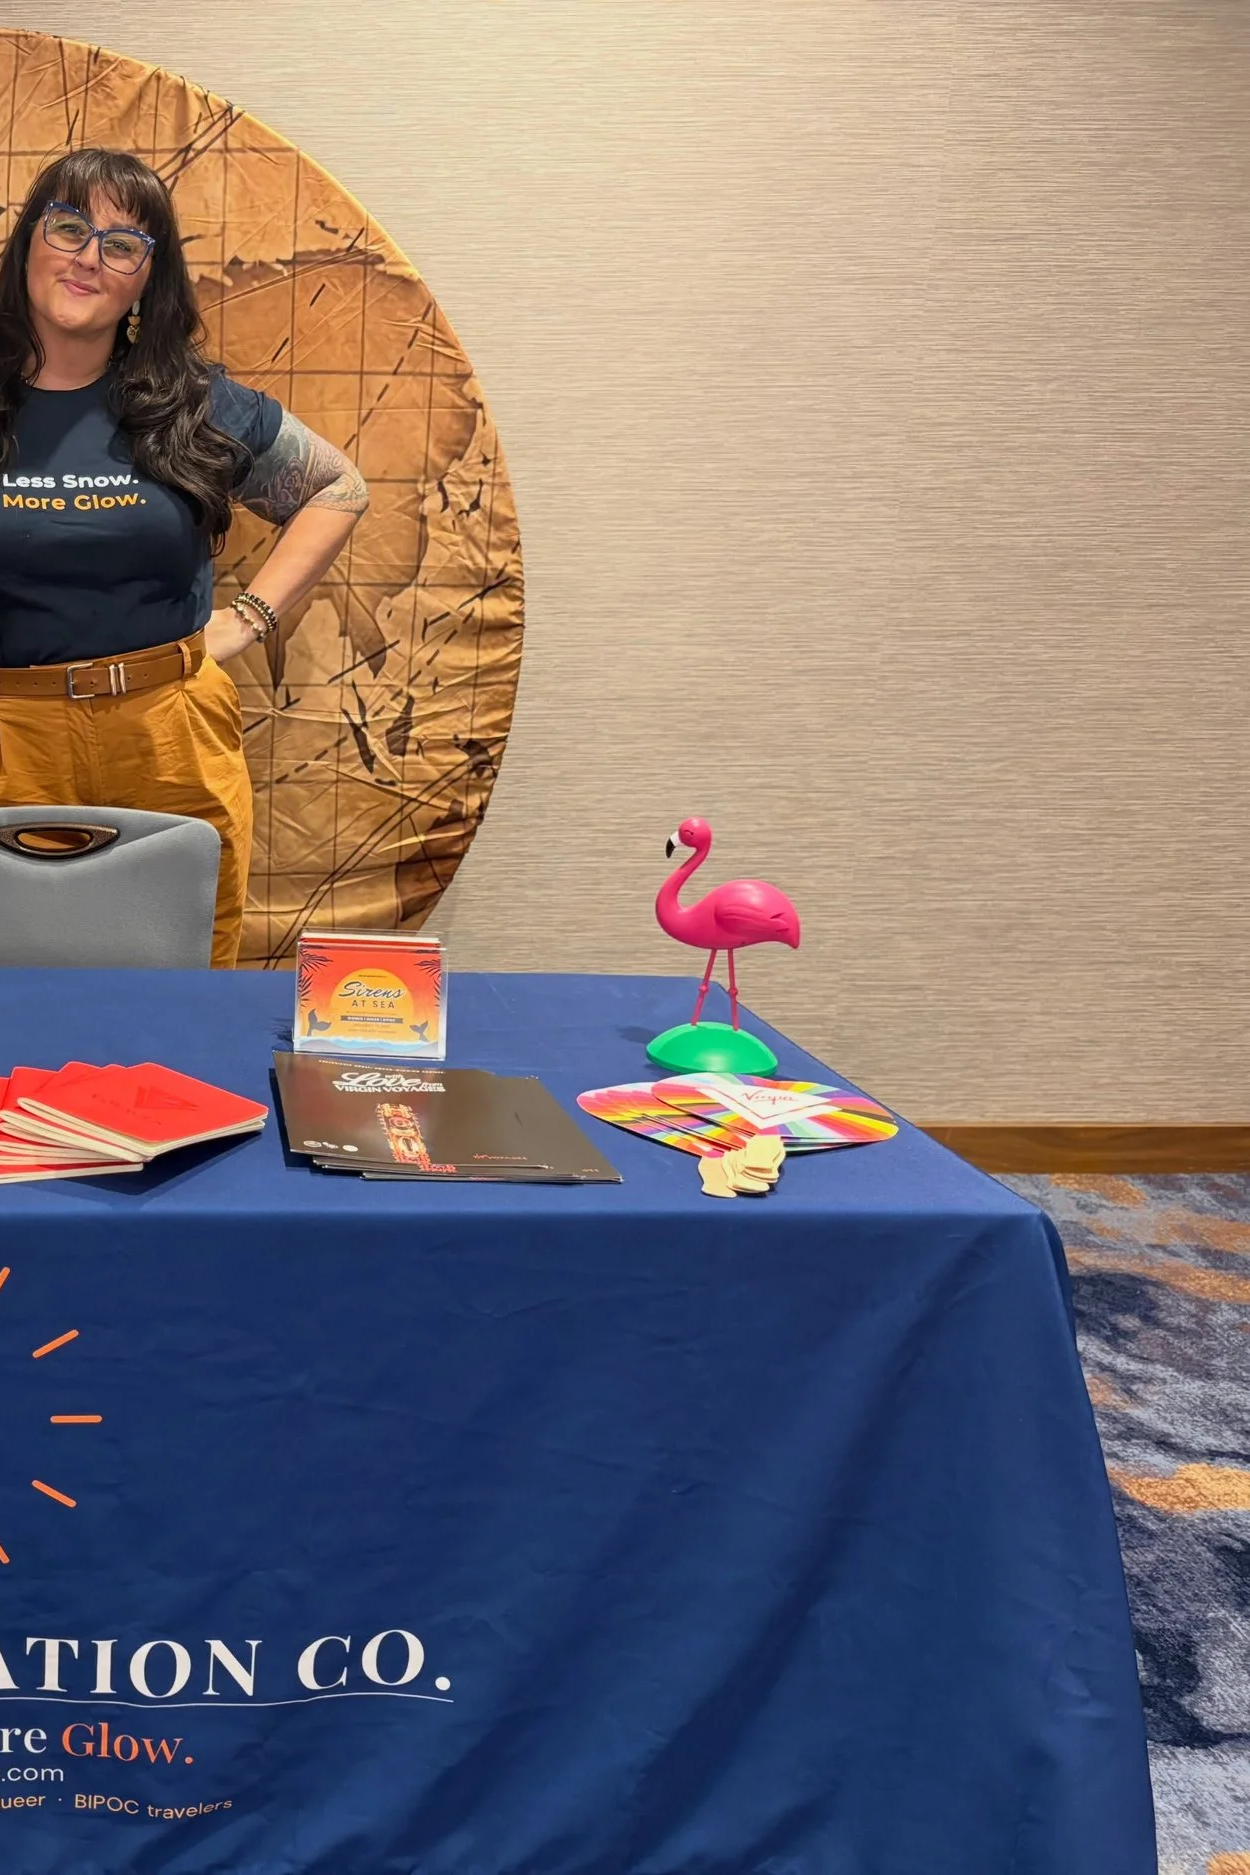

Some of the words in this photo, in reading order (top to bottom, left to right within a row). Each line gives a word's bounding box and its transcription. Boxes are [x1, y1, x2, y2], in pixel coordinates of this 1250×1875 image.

[3, 474, 56, 488] Less
[62, 474, 139, 489] Snow.
[3, 494, 66, 510] More
[74, 493, 147, 510] Glow.
[338, 981, 403, 999] Sirens
[352, 1000, 366, 1008] AT
[372, 1000, 395, 1009] SEA
[332, 1072, 421, 1087] Love
[334, 1085, 381, 1093] VIRGIN
[297, 1629, 451, 1691] CO.
[62, 1722, 194, 1764] Glow.
[74, 1793, 139, 1814] BIPOC
[147, 1800, 233, 1819] travelers
